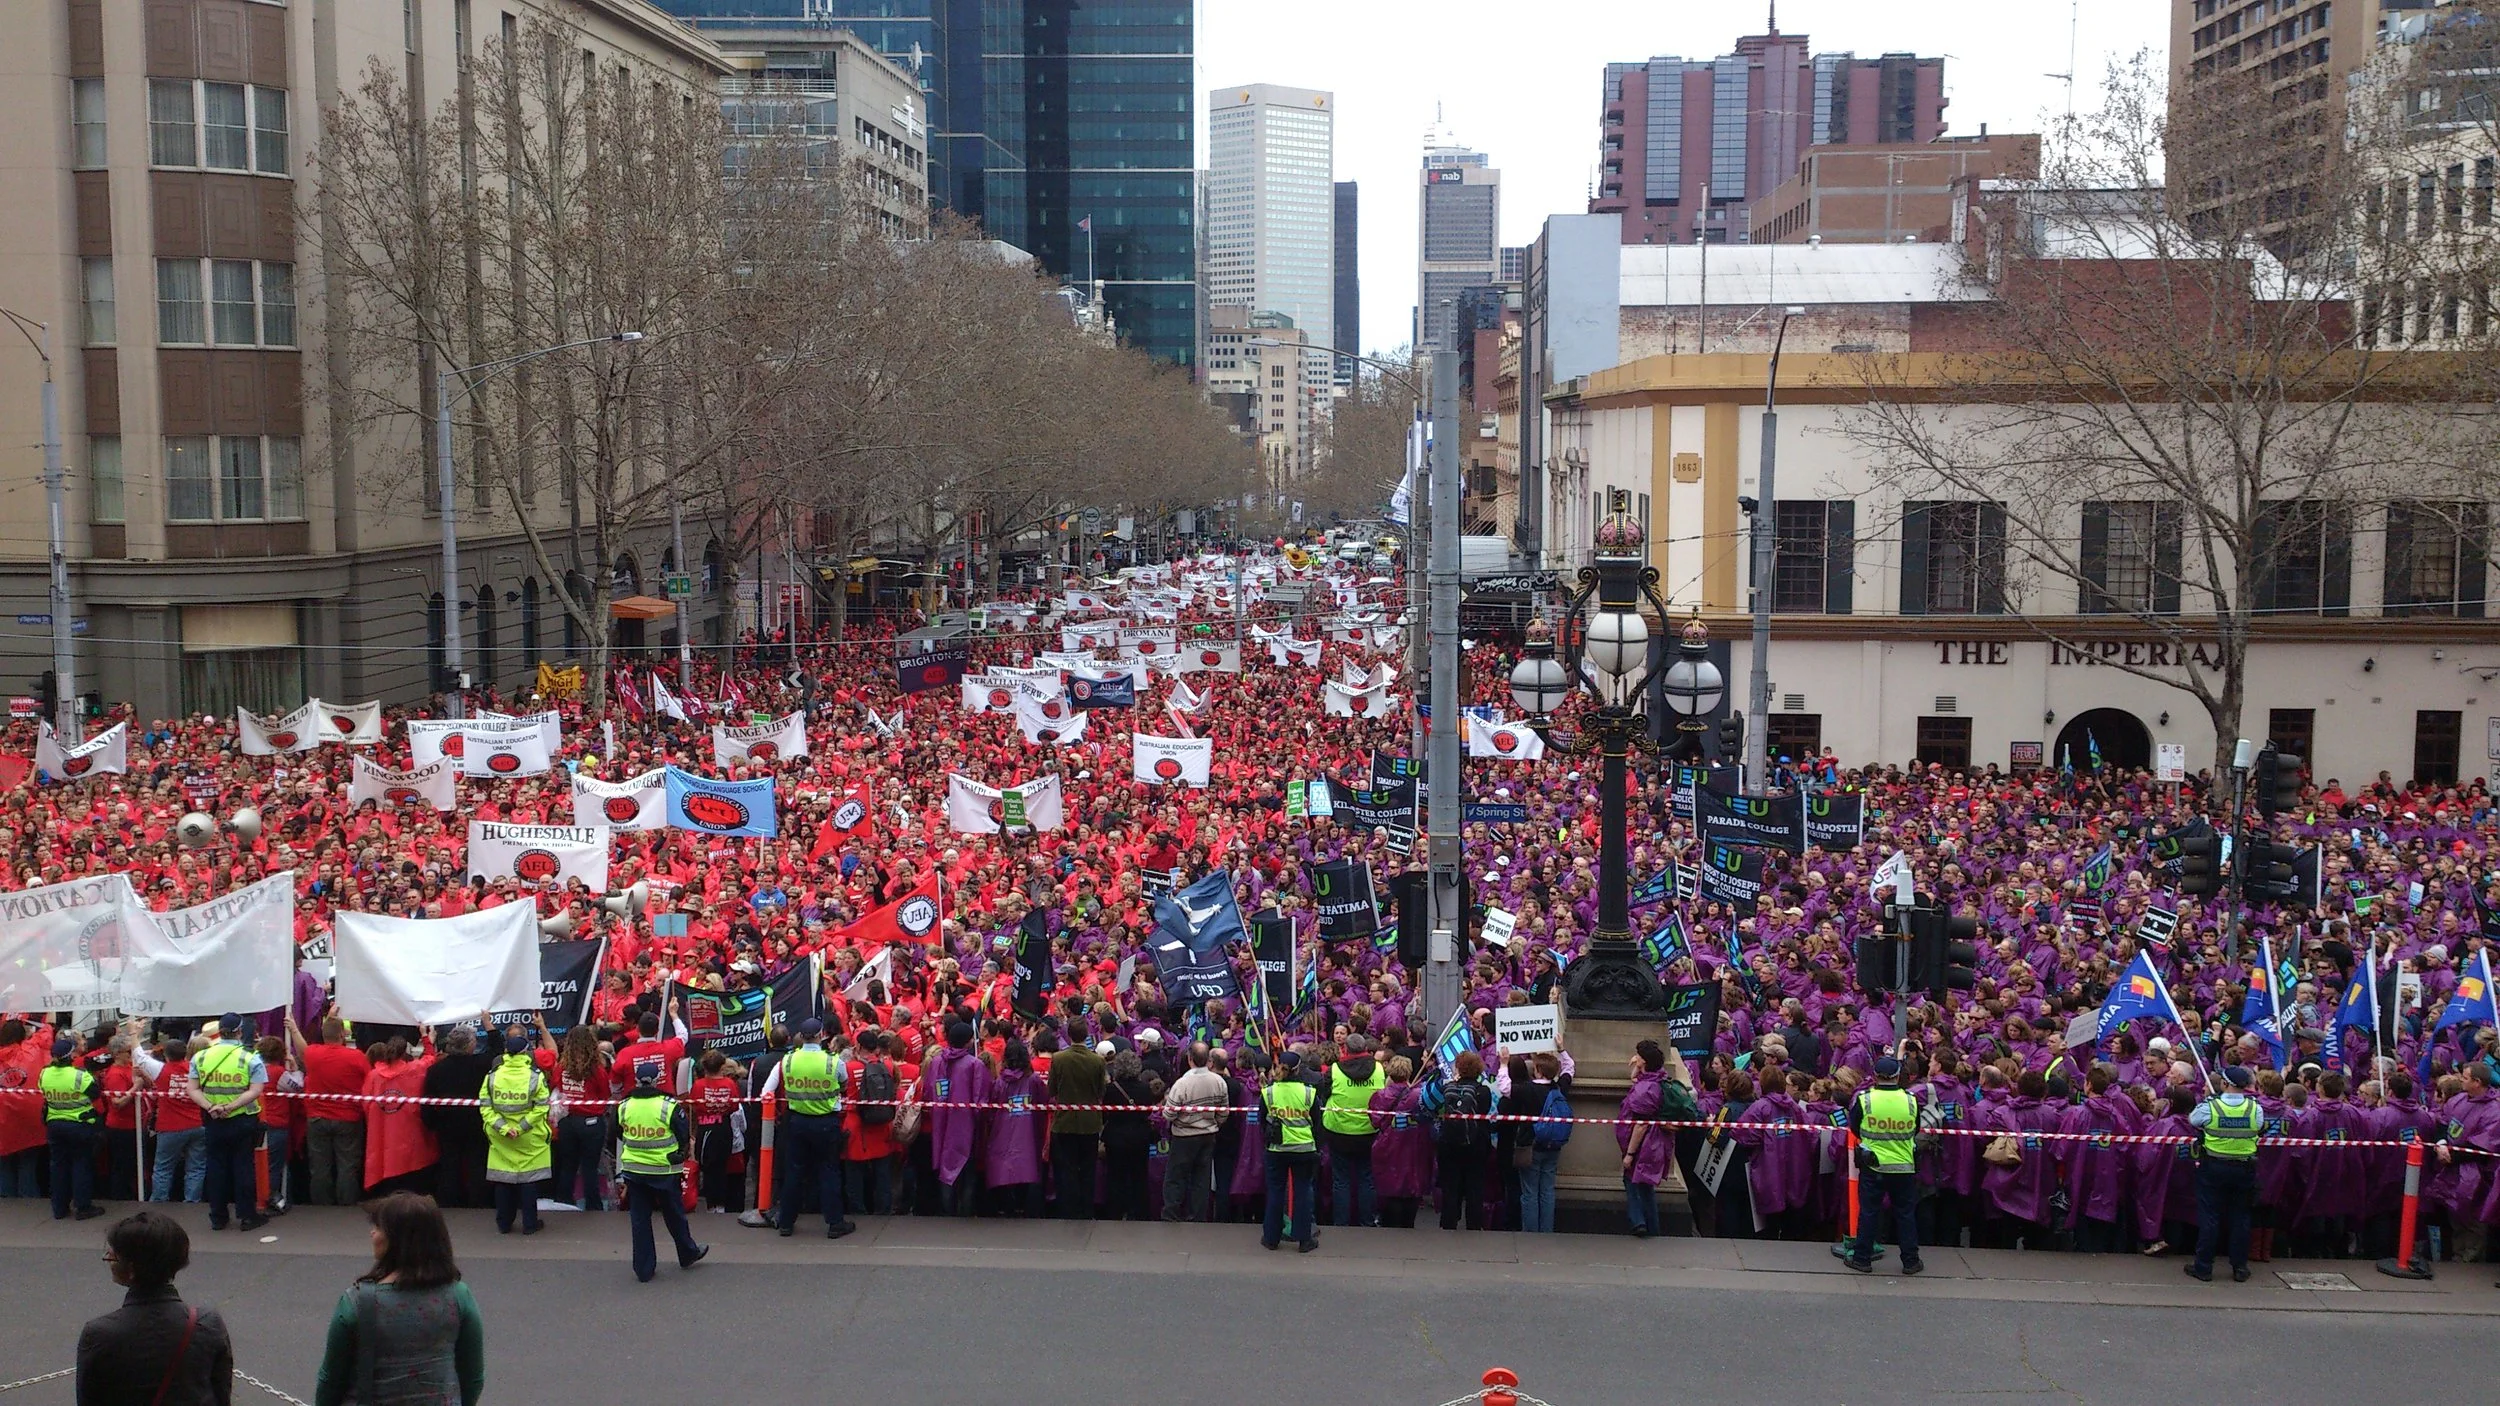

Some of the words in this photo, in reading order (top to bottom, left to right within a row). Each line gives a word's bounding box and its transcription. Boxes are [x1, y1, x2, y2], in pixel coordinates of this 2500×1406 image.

[1442, 172, 1460, 181] nab
[1677, 463, 1697, 472] 1863
[1123, 629, 1171, 638] DROMANA
[900, 652, 951, 669] BRIGHTON
[1934, 641, 2008, 665] THE
[724, 726, 761, 739] RANGE
[763, 717, 792, 734] VIEW
[467, 736, 503, 745] AUSTRALIAN
[506, 734, 538, 744] EDUCATION
[1139, 741, 1171, 750] AUSTRALIAN
[1496, 738, 1514, 746] AEU
[363, 763, 440, 780] RINGWOOD
[1392, 759, 1420, 776] IEU
[710, 784, 742, 794] LANGUAGE
[742, 784, 767, 794] SCHOOL
[1476, 806, 1510, 819] Spring
[1512, 807, 1525, 817] St
[1726, 797, 1769, 817] IEU
[1807, 797, 1830, 817] EU
[699, 820, 727, 831] UNION
[1707, 816, 1746, 829] PARADE
[1747, 822, 1790, 835] COLLEGE
[1816, 823, 1857, 833] APOSTLE
[481, 823, 595, 844] HUGHESDALE
[520, 861, 554, 872] AEU
[1713, 846, 1742, 872] IEU
[1727, 873, 1761, 892] JOSEPH
[1720, 884, 1752, 900] COLLEGE
[1327, 900, 1369, 915] FATIMA
[1485, 923, 1495, 932] NO
[1495, 925, 1509, 938] WAY!
[1500, 1019, 1540, 1027] Performance
[1541, 1018, 1554, 1026] pay
[1500, 1031, 1519, 1043] NO
[1521, 1028, 1553, 1041] WAY!
[199, 1070, 242, 1083] Police
[786, 1075, 831, 1090] Police
[1346, 1077, 1375, 1088] UNION
[494, 1089, 527, 1100] Police
[1868, 1115, 1914, 1131] Police
[2219, 1115, 2250, 1129] Police
[623, 1123, 666, 1138] Police
